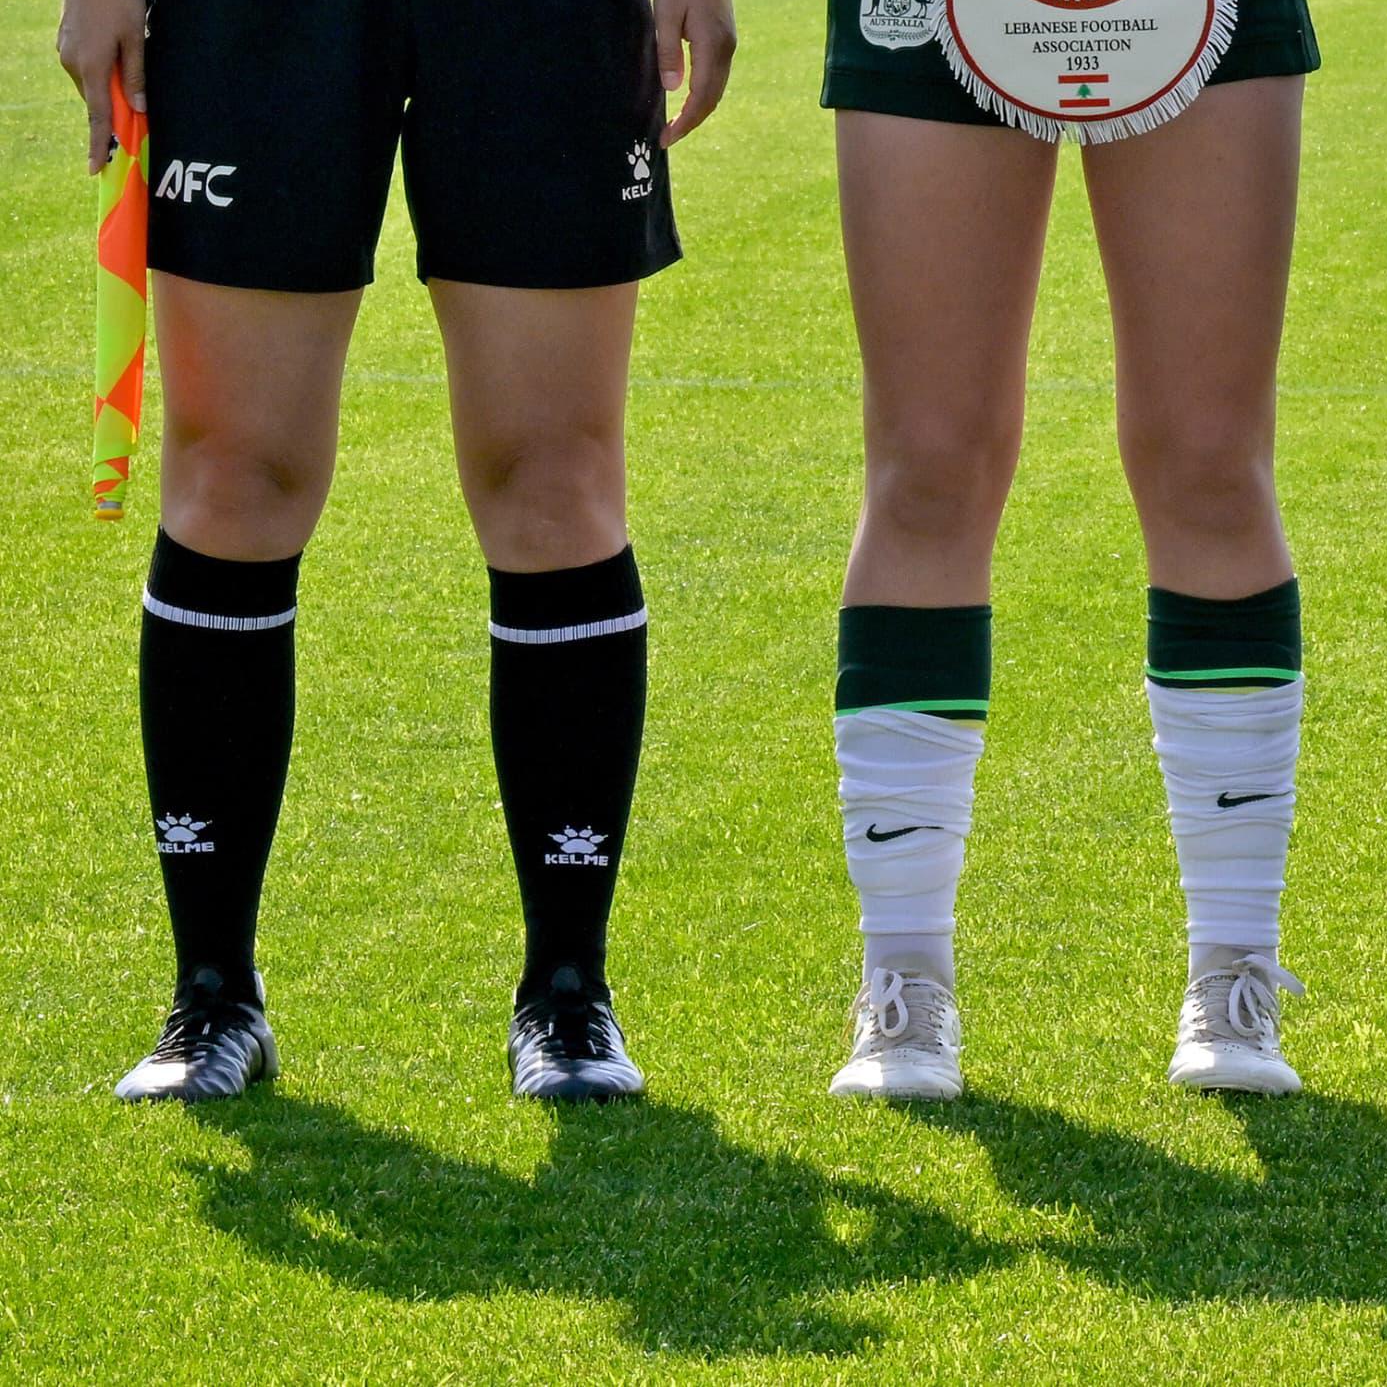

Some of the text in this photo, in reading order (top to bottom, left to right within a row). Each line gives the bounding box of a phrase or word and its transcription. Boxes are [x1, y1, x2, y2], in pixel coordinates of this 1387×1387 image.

[869, 18, 925, 28] AUSTRALIA
[1004, 19, 1159, 35] LEBANESE FOOTBALL
[1032, 39, 1132, 54] ASSOCIATION
[1066, 56, 1100, 71] 1933
[155, 159, 237, 207] AFC
[156, 840, 215, 854] KELME
[544, 853, 609, 866] KELME
